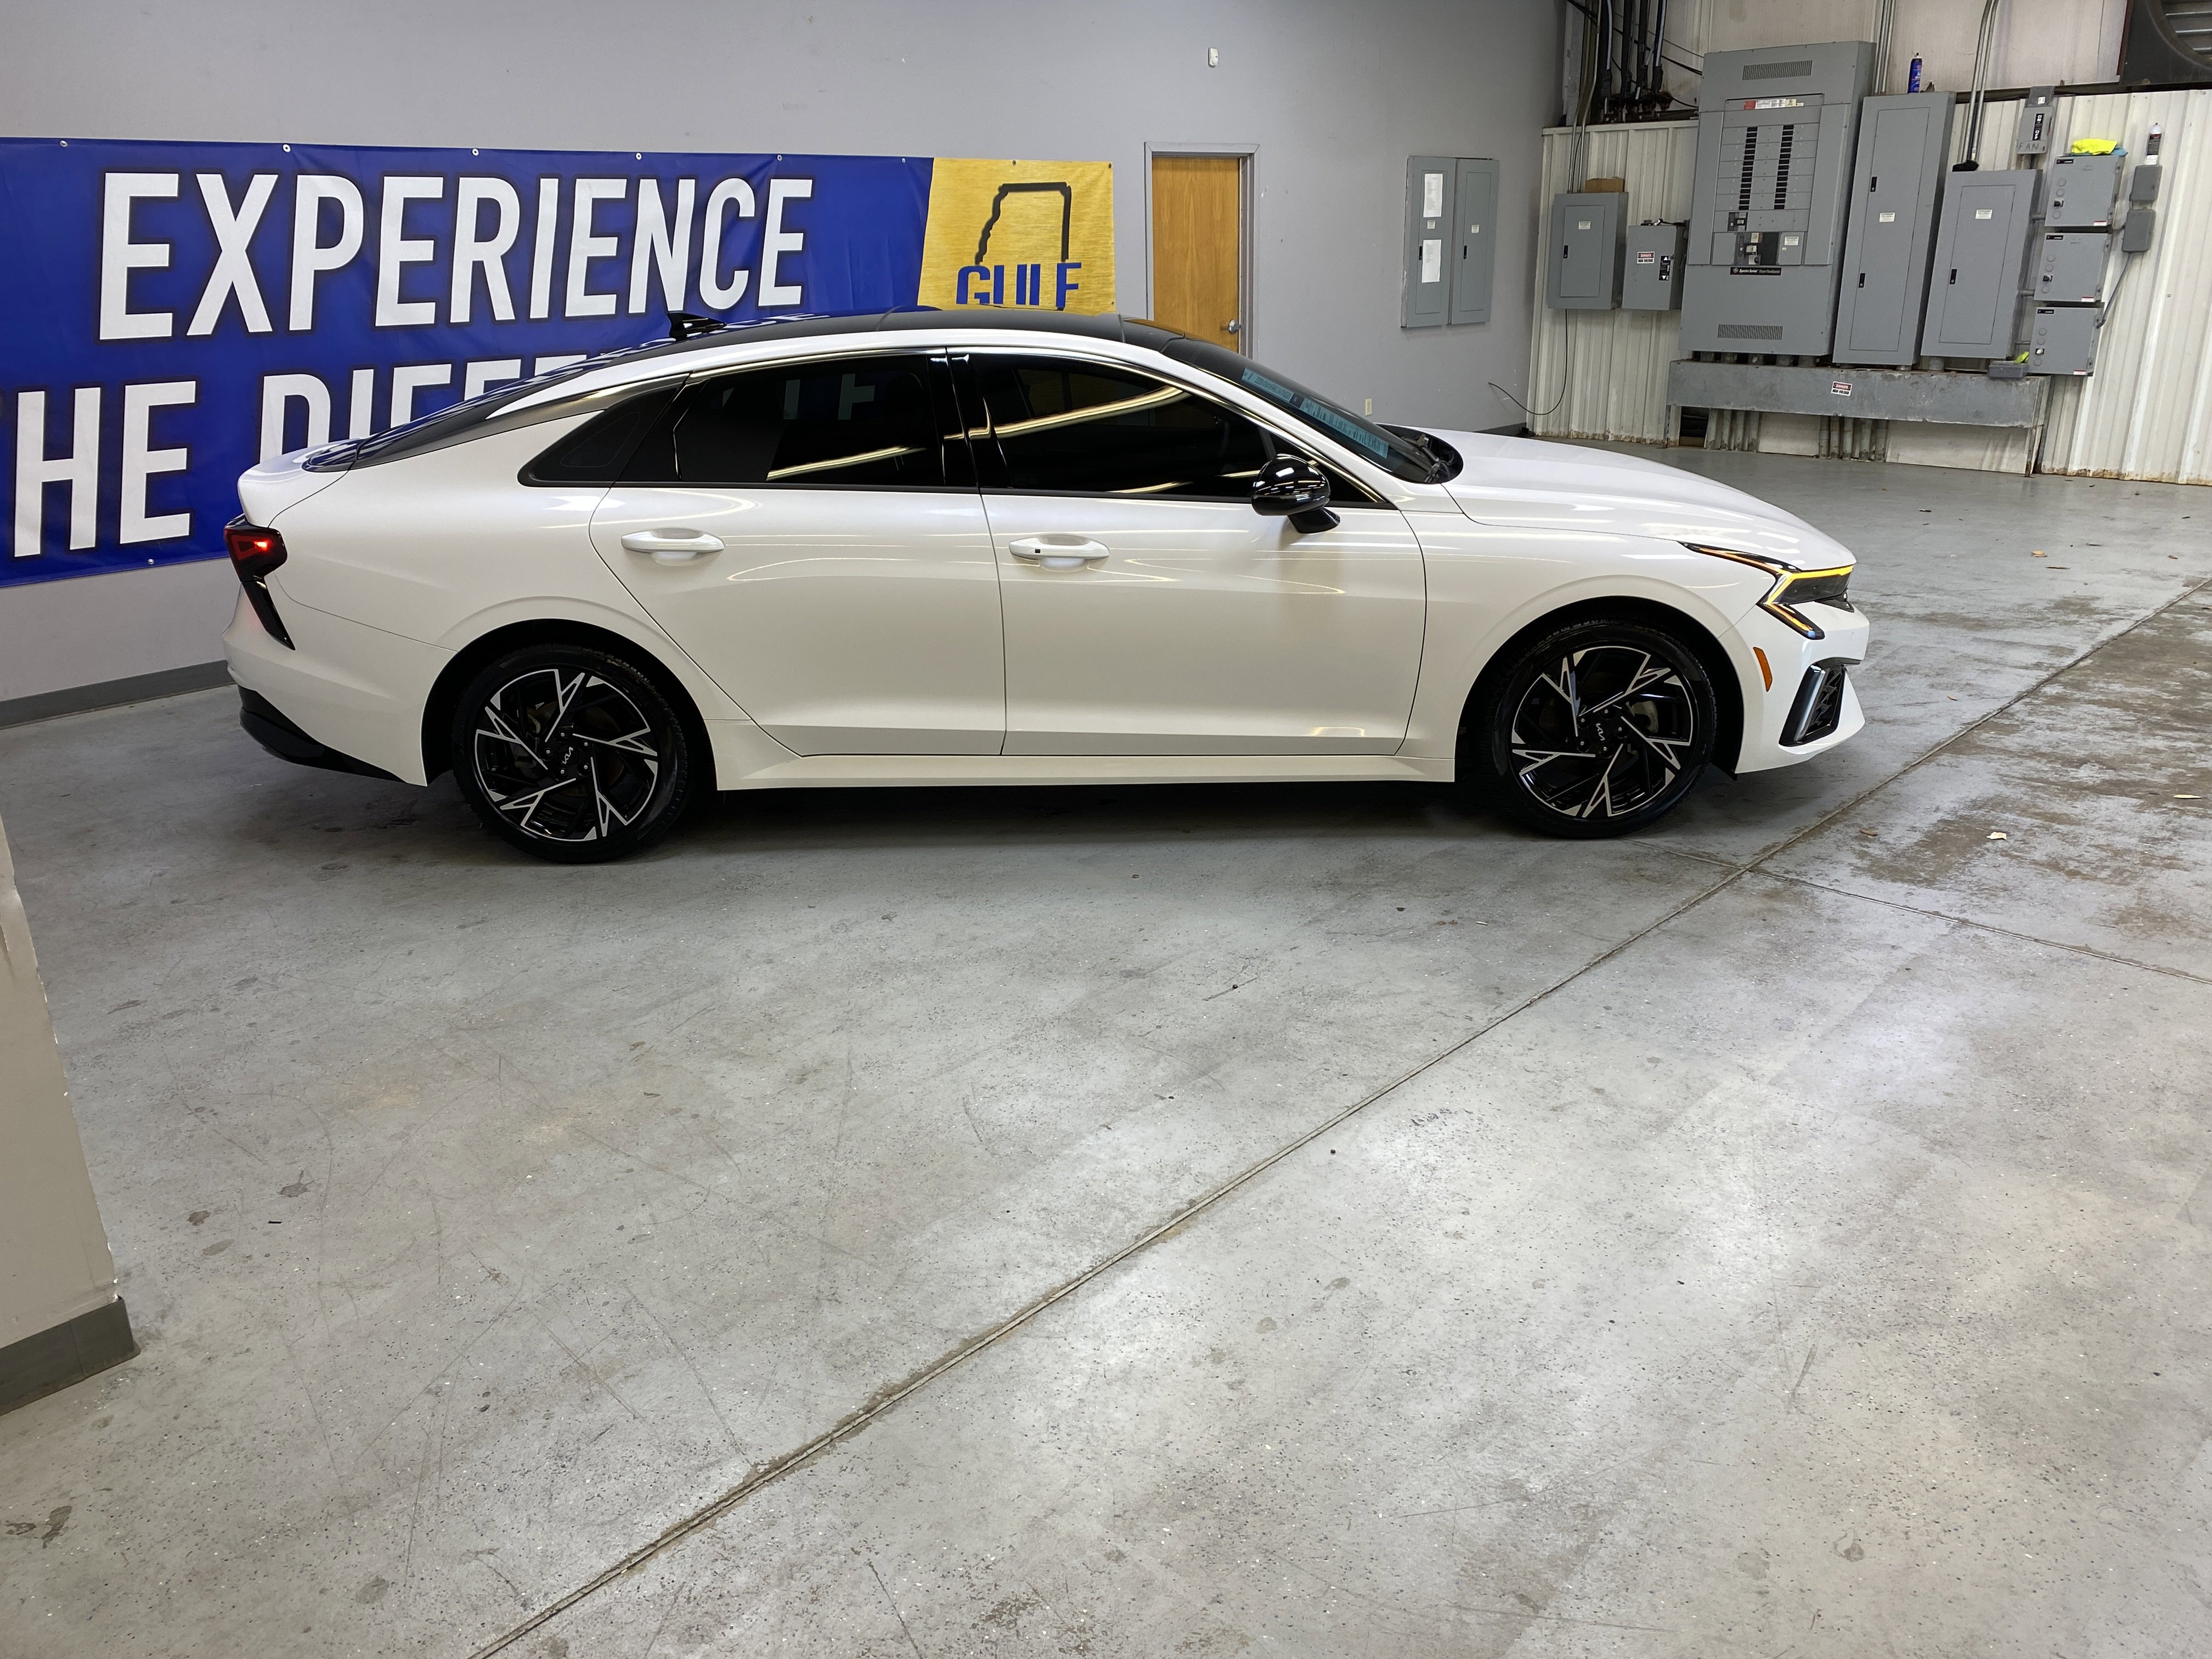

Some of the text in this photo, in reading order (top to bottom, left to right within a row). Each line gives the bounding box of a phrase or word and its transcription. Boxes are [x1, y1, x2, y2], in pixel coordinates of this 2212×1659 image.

[2018, 143, 2039, 151] FAN
[99, 172, 812, 340] EXPERIENCE
[14, 380, 196, 557] HE
